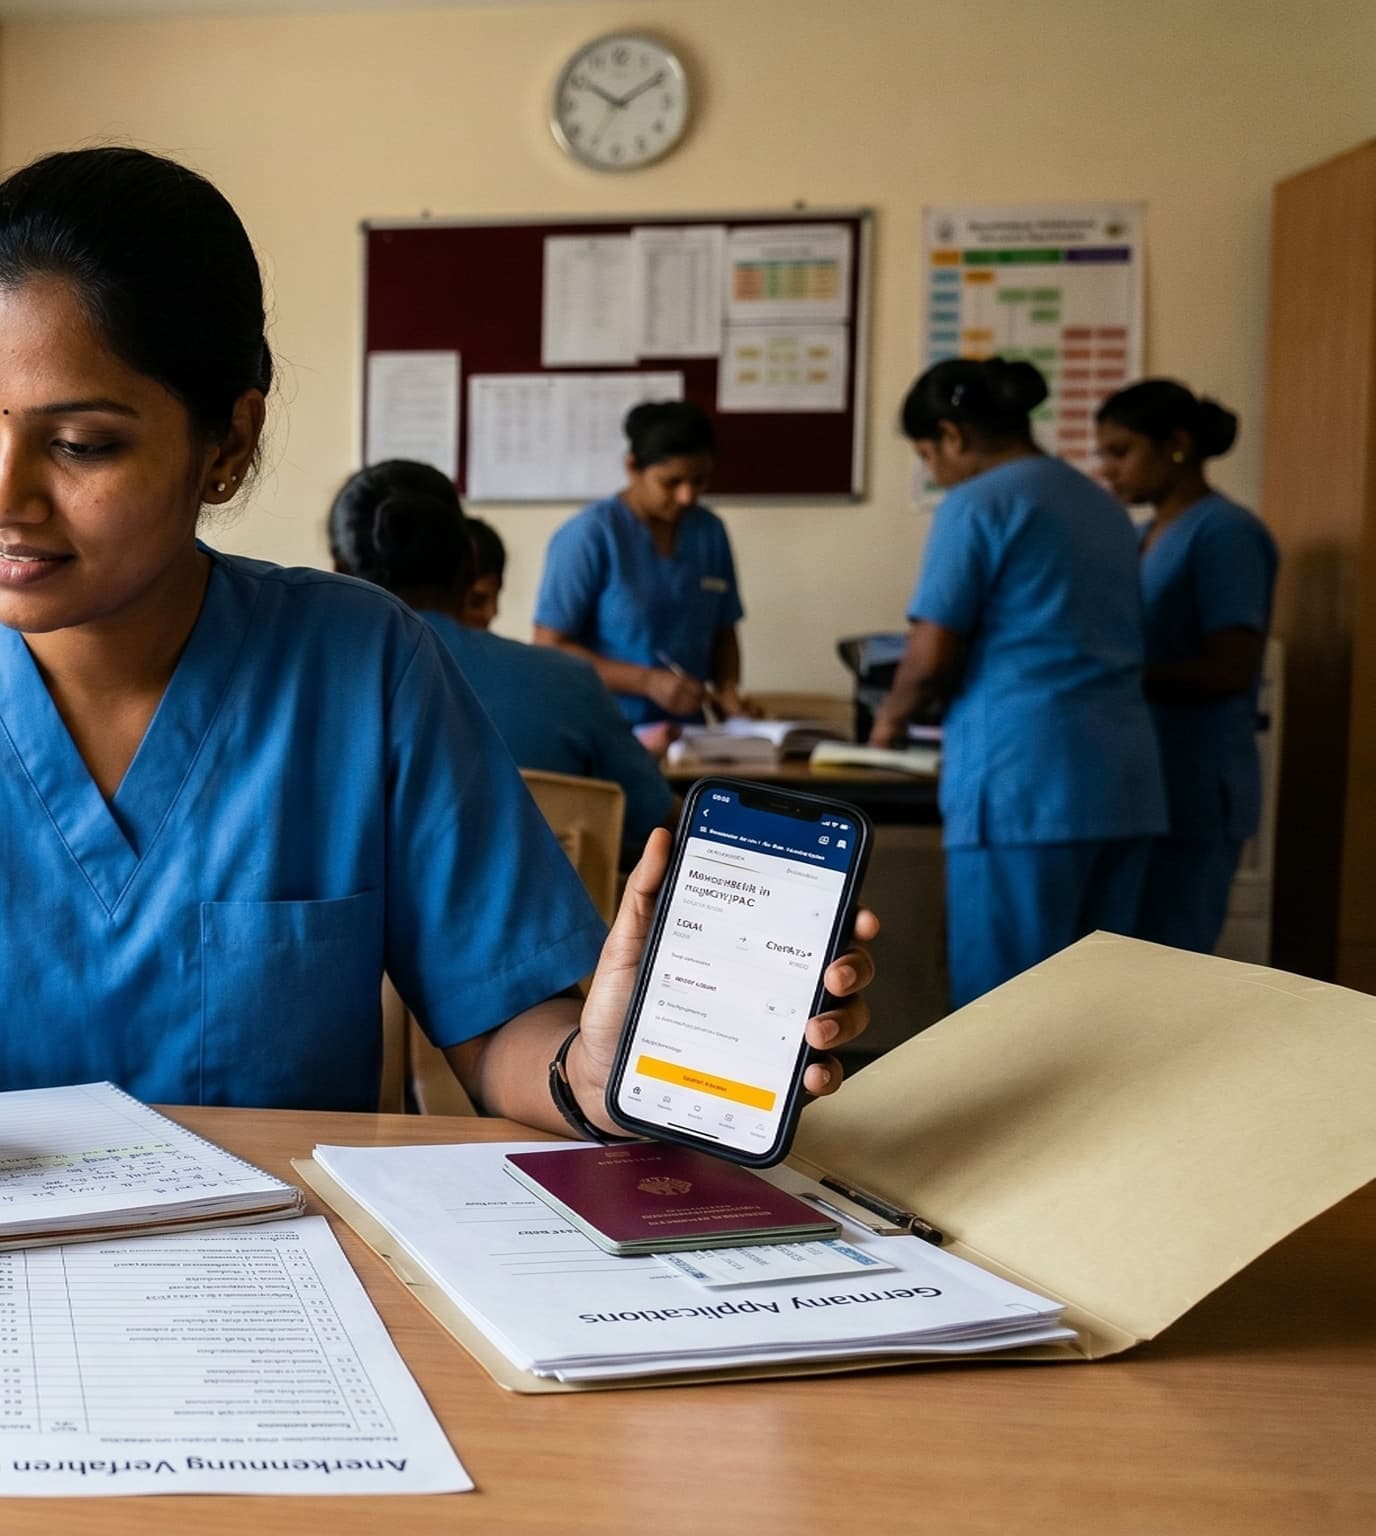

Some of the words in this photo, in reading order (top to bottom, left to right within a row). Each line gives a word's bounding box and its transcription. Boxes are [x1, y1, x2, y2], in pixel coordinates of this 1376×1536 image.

[790, 1287, 944, 1312] Germany
[579, 1299, 780, 1324] Applications
[13, 1457, 176, 1475] Verfahren
[187, 1456, 408, 1475] Anerkennung
